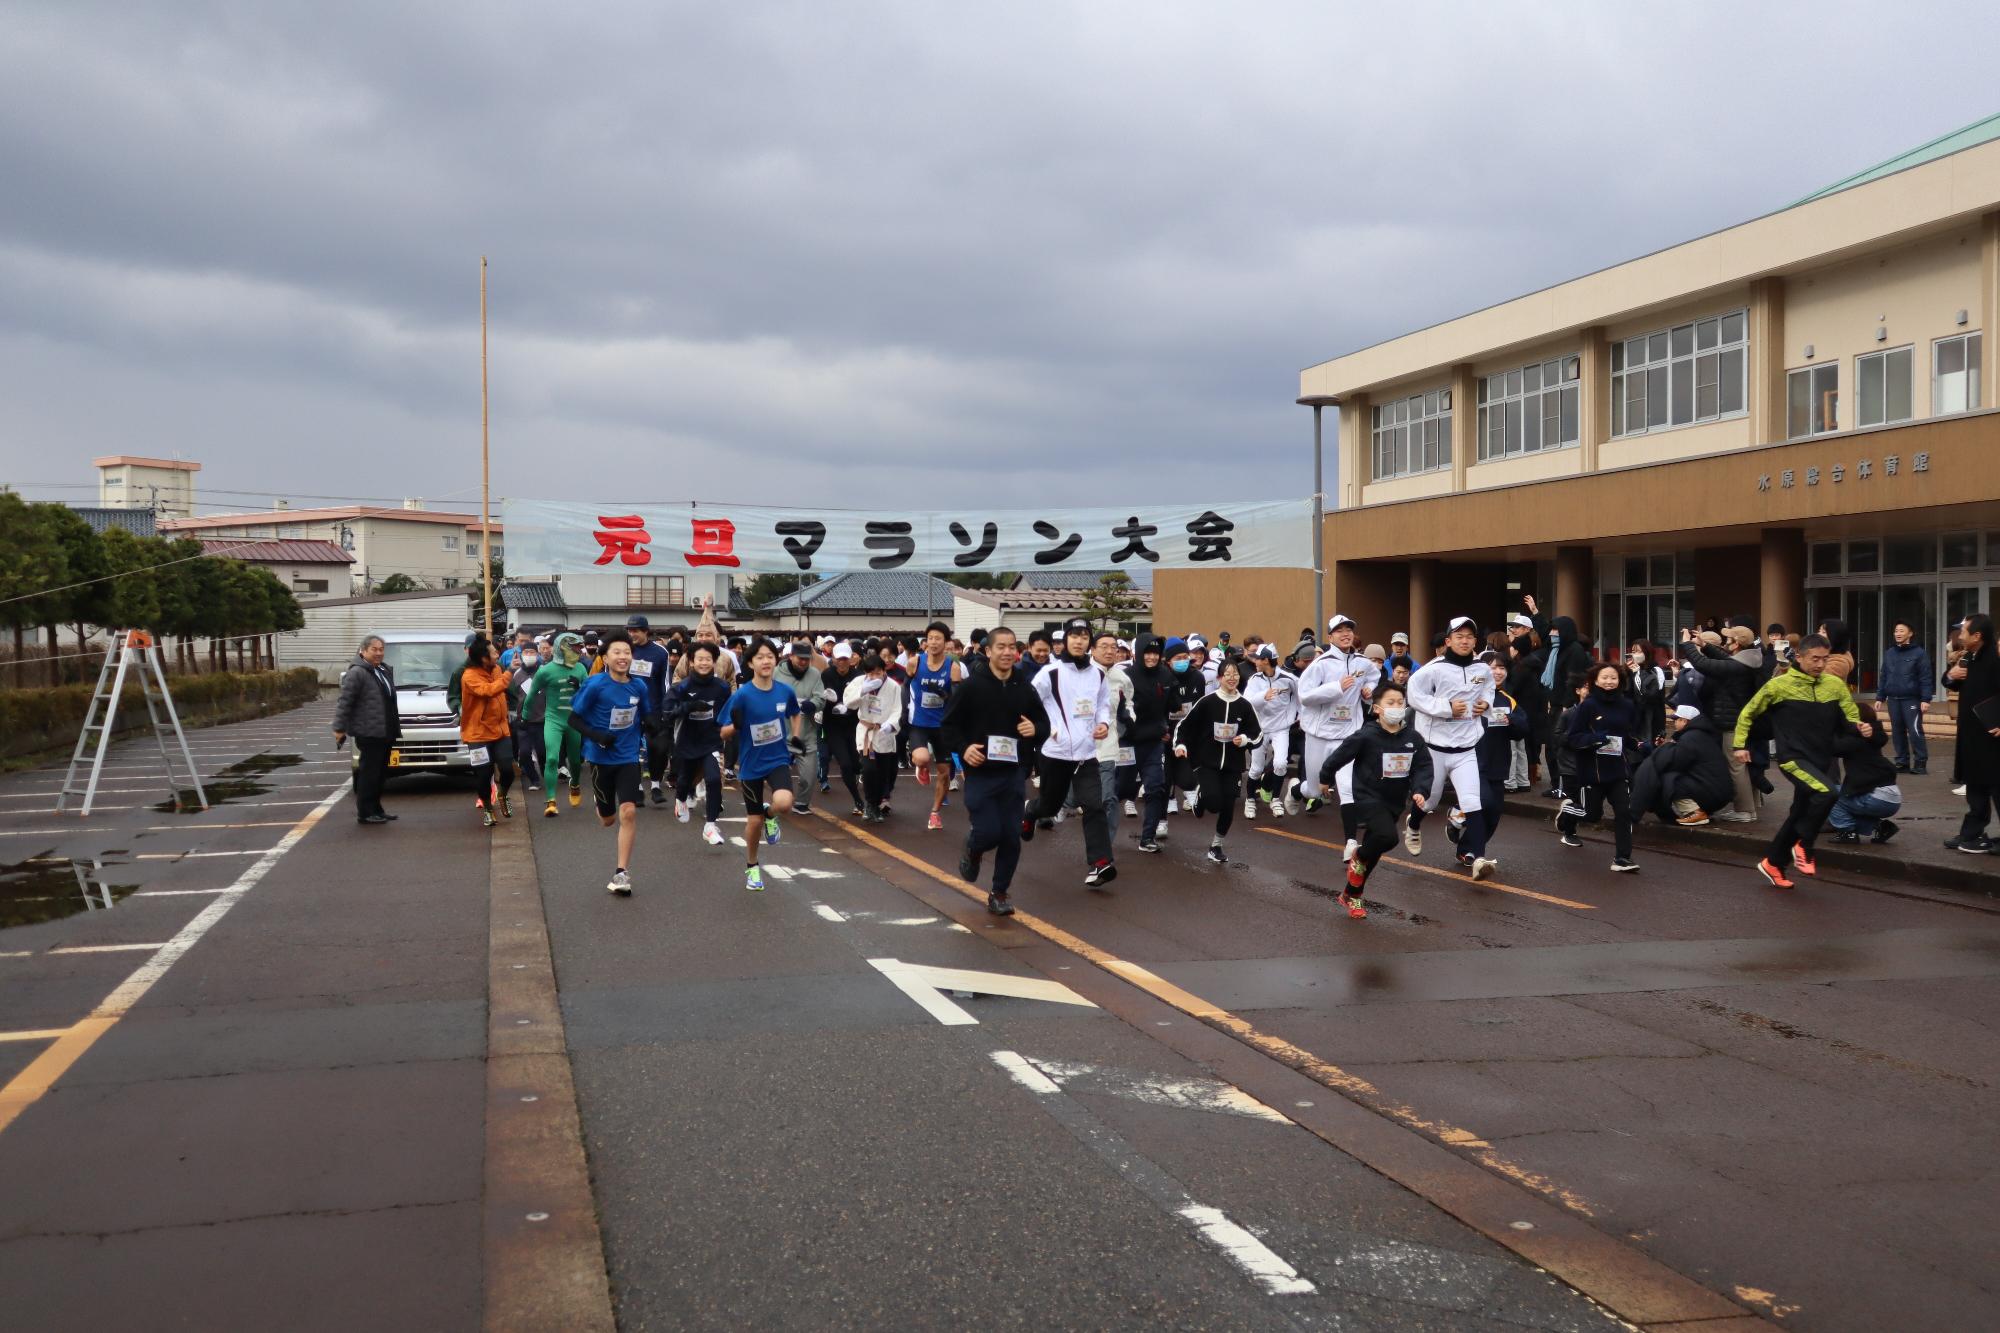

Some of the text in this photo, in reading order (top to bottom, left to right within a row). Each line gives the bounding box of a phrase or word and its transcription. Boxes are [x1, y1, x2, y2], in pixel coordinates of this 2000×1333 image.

[592, 510, 1235, 570] 元旦マラソン大会
